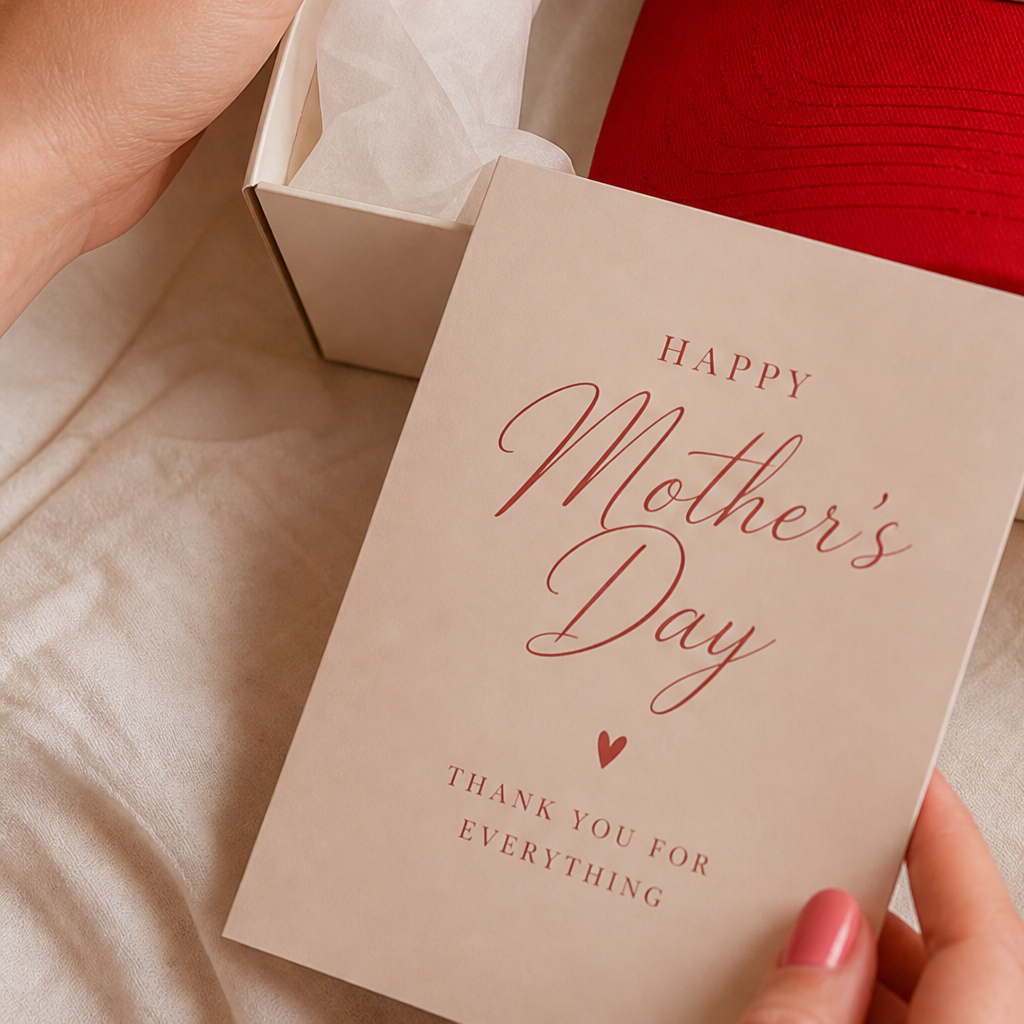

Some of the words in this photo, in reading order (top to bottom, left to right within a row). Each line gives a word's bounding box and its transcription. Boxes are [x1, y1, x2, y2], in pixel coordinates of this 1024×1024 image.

[657, 334, 812, 400] HAPPY
[494, 382, 912, 569] Mother's
[526, 524, 776, 715] Day
[447, 765, 557, 821] THANK
[571, 809, 636, 848] YOU
[648, 837, 712, 876] FOR
[458, 818, 664, 909] EVERYTHING
